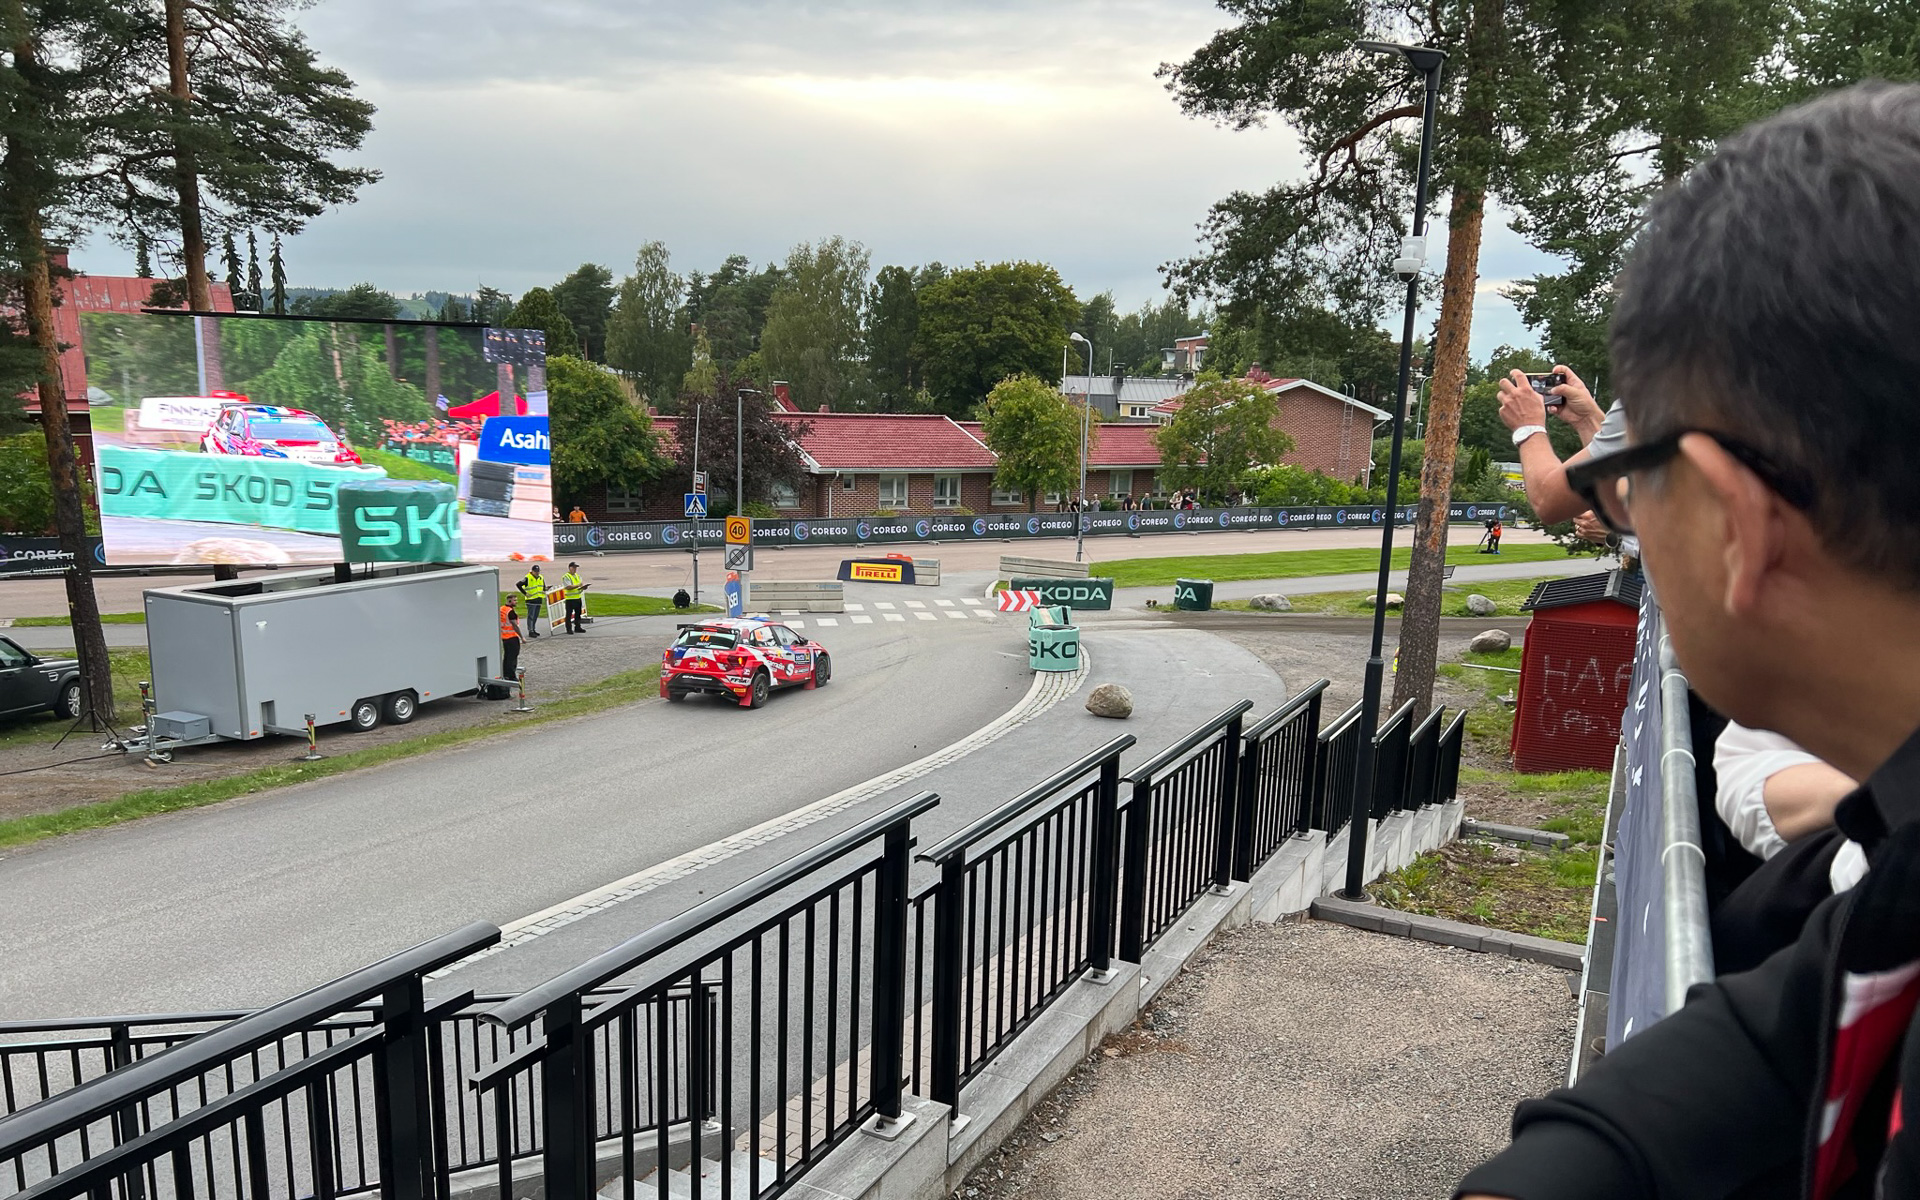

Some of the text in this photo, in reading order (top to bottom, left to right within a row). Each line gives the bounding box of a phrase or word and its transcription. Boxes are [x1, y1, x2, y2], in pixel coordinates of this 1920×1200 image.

[499, 427, 550, 450] Asahi
[607, 531, 652, 542] COREGO
[752, 528, 791, 537] COREGO
[811, 527, 848, 536] COREGO
[872, 525, 908, 535] COREGO
[931, 523, 966, 532] COREGO
[988, 522, 1021, 531] COREGO
[1041, 521, 1073, 530] COREGO
[1092, 519, 1122, 528] COREGO
[1141, 517, 1169, 526] COREGO
[1186, 516, 1214, 524] COREGO
[1231, 515, 1258, 523] COREGO
[1289, 513, 1315, 521] COREGO
[1347, 512, 1371, 520] COREGO
[732, 525, 744, 536] 40
[855, 566, 898, 579] PIRELLI
[1029, 640, 1080, 659] SKO
